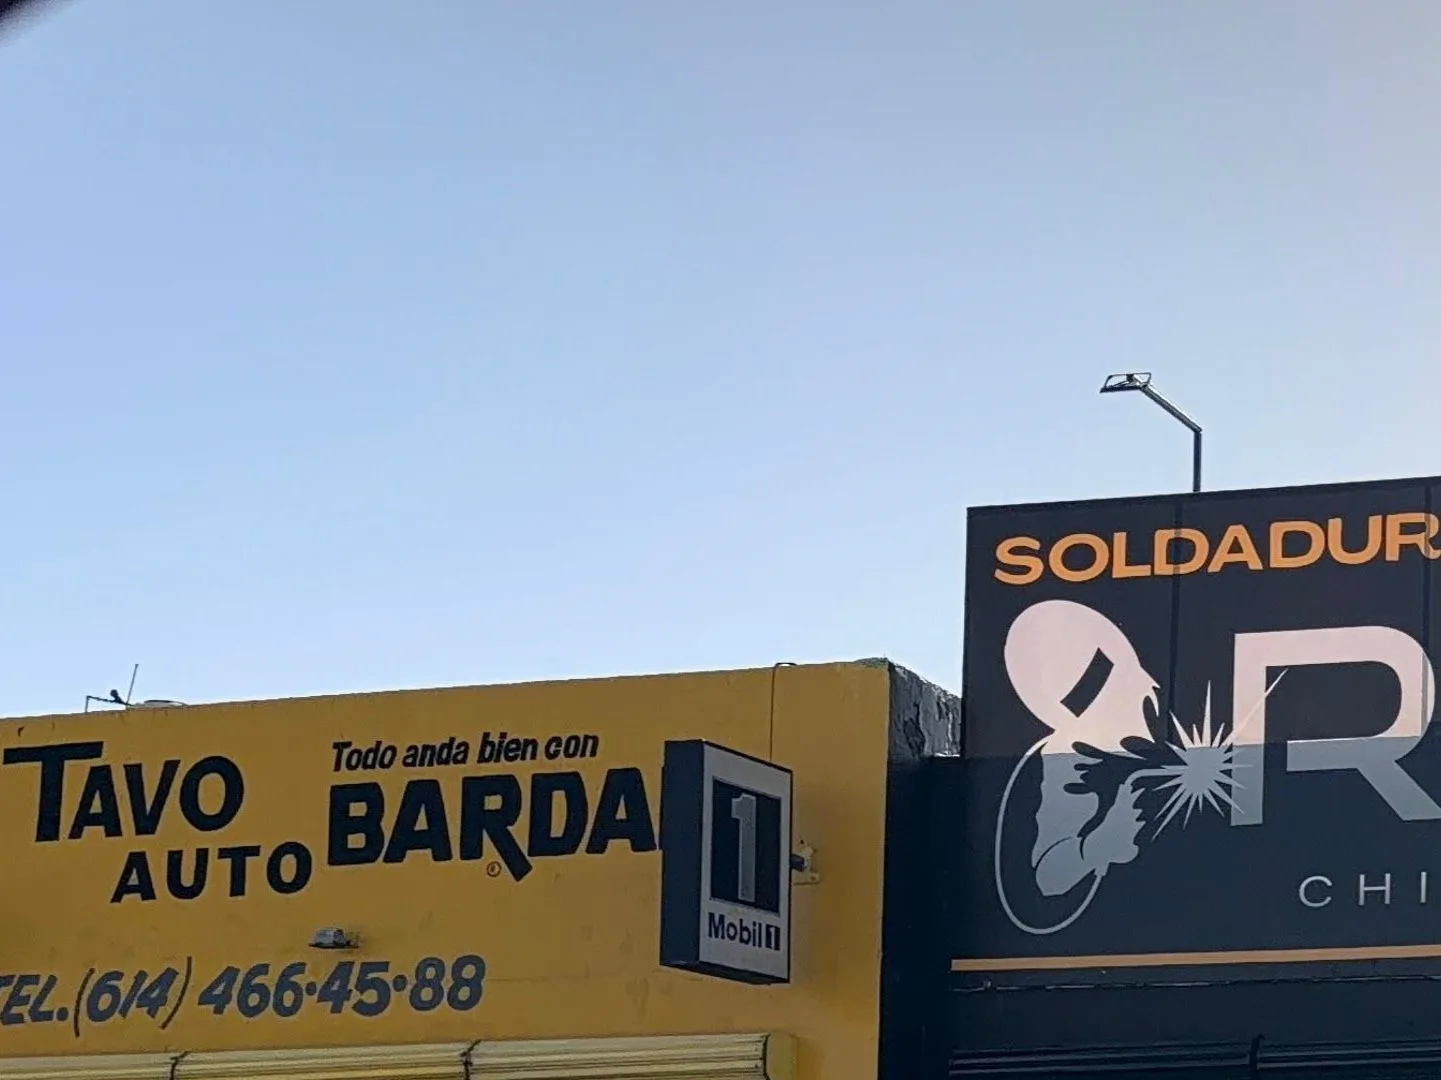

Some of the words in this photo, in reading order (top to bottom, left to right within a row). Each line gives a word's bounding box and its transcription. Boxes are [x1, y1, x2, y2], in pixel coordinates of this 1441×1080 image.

[3, 741, 244, 842] TAVO
[332, 740, 397, 773] Todo
[402, 736, 469, 768] anda
[477, 731, 538, 763] bien
[545, 734, 599, 759] con
[328, 766, 664, 881] BARDA
[731, 793, 758, 903] 1
[110, 841, 313, 903] AUTO
[708, 912, 763, 948] Mobil
[73, 956, 192, 1038] (614)
